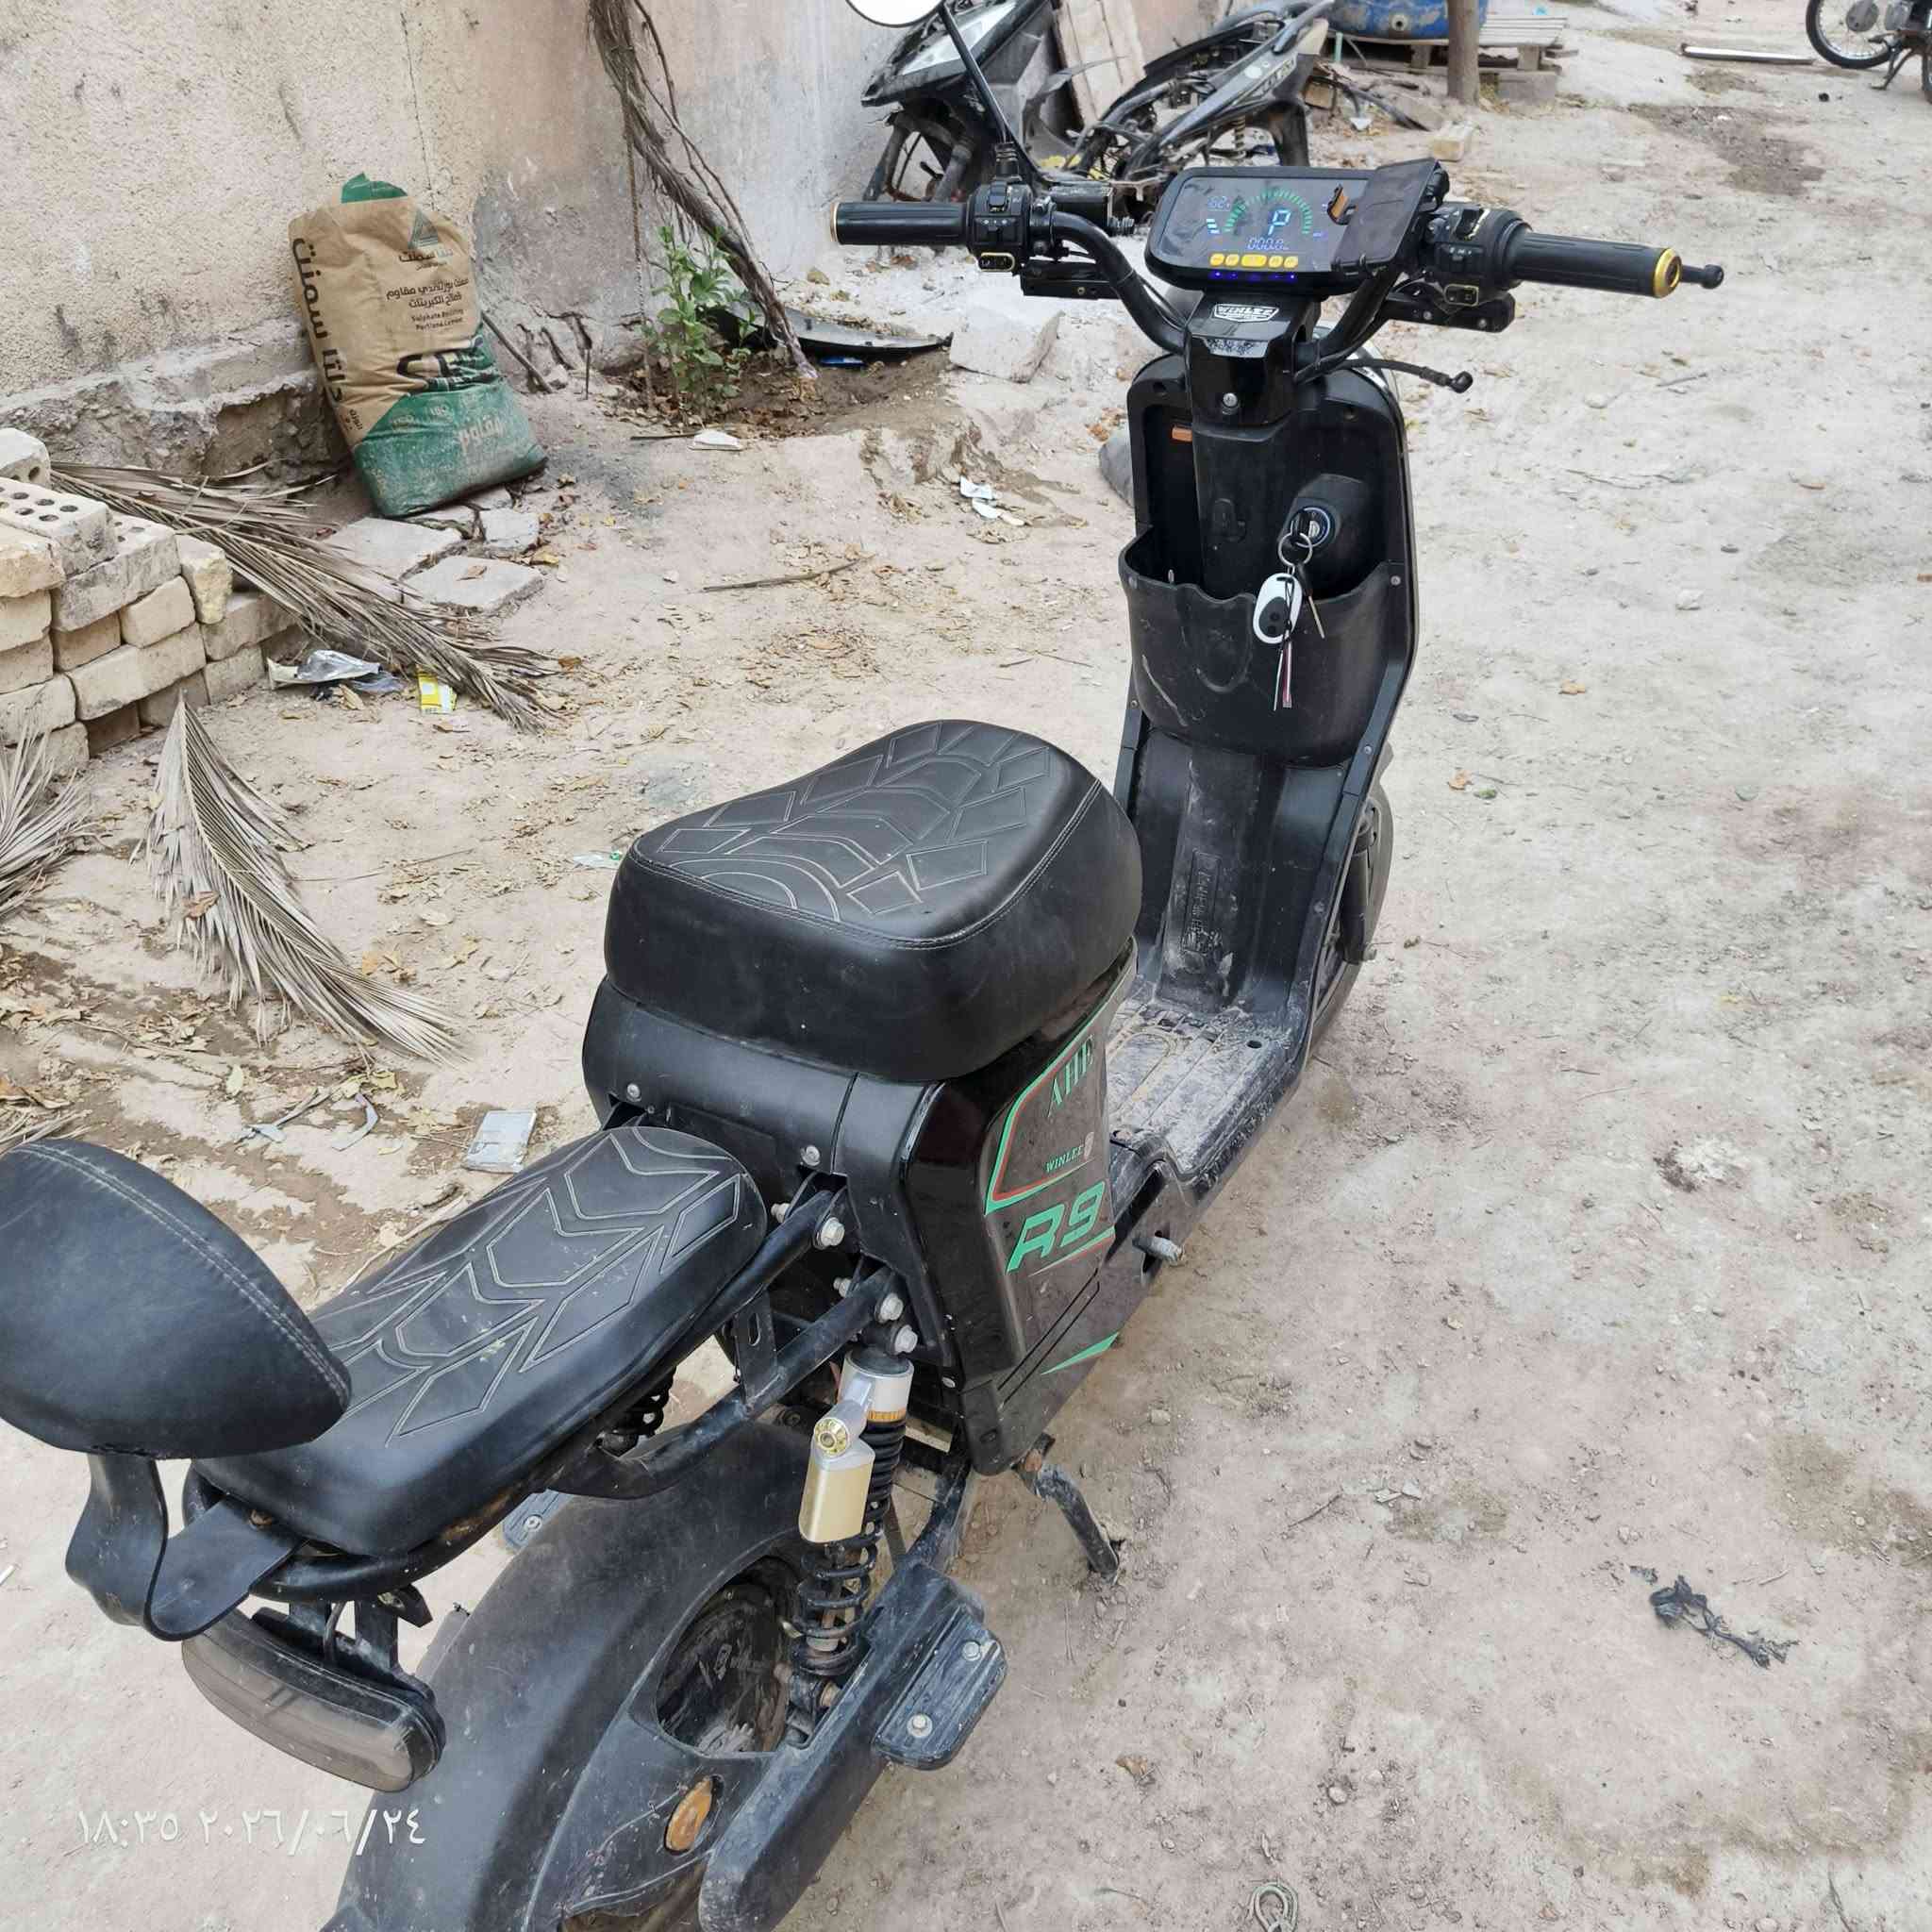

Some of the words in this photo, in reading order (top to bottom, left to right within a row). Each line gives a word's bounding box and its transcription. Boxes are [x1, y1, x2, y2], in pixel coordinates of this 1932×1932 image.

[1267, 208, 1291, 236] P
[292, 238, 327, 340] سمنت
[386, 287, 416, 301] مقاوم
[1006, 1181, 1105, 1272] R9
